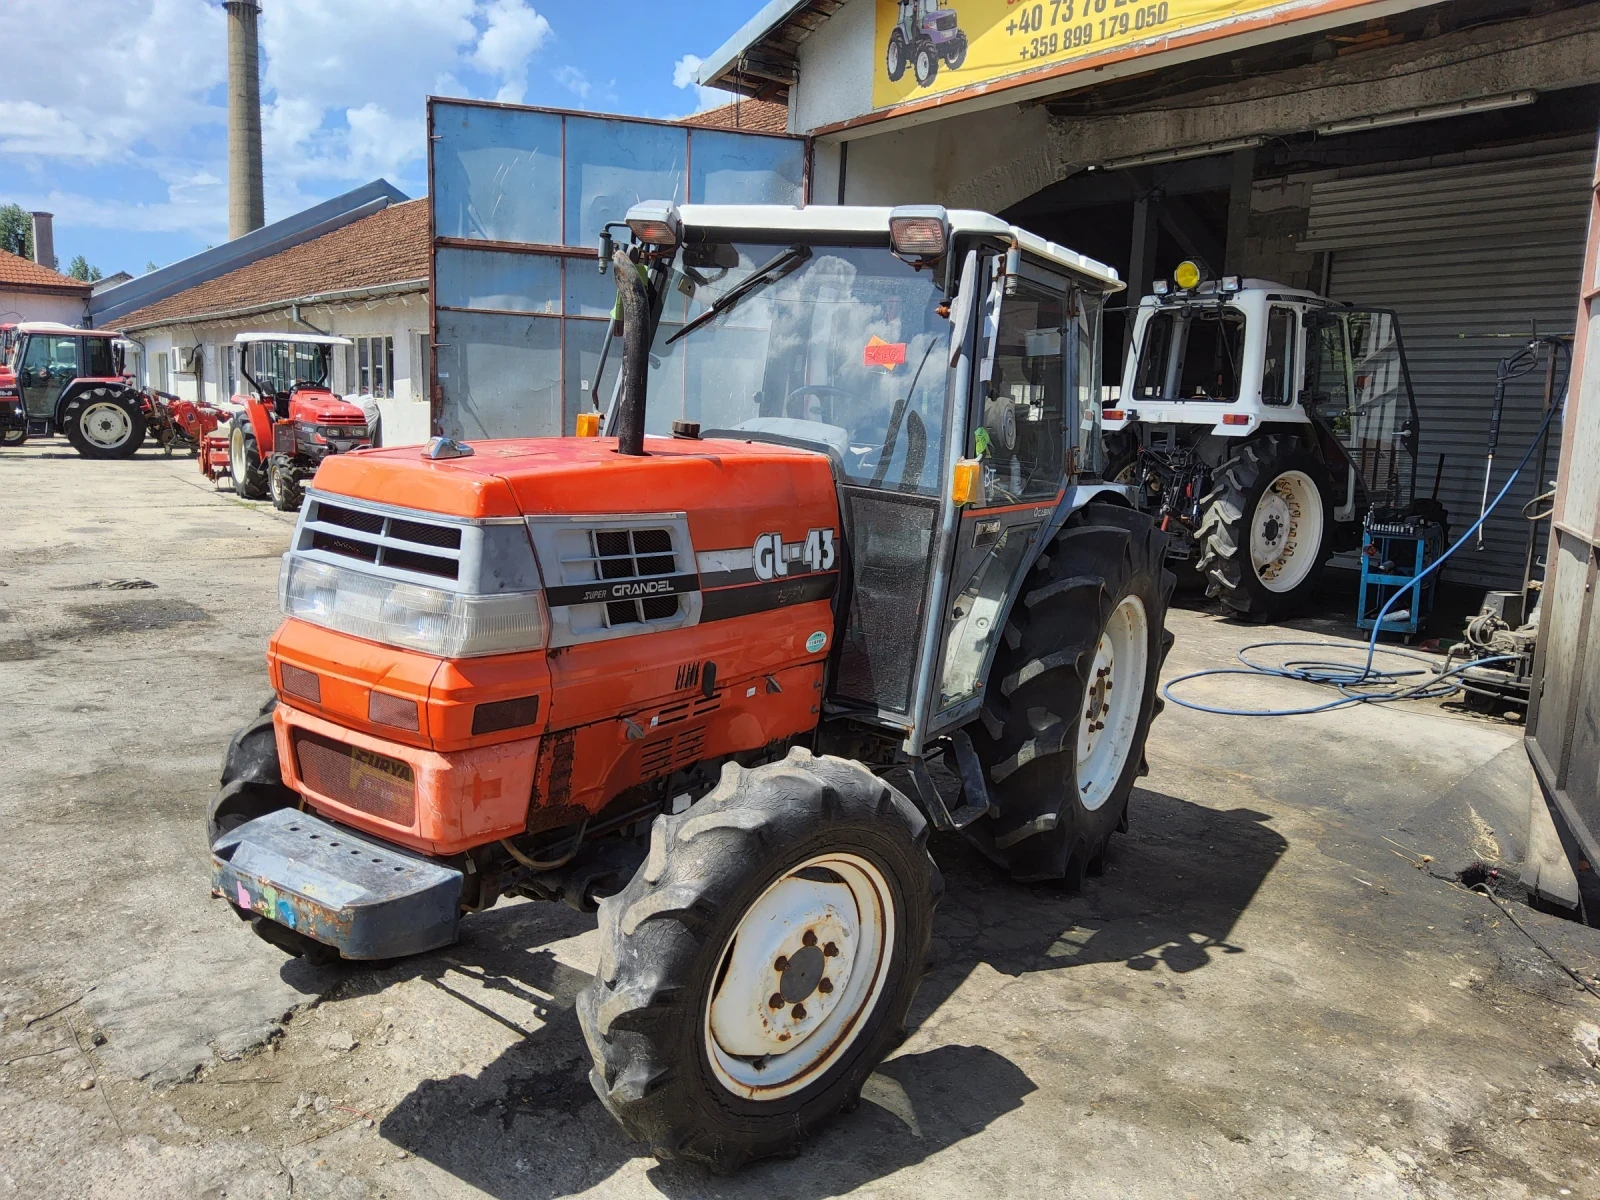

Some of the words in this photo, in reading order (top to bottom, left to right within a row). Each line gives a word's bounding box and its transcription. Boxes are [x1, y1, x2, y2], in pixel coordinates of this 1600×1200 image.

[1006, 4, 1043, 35] +40
[1050, 0, 1074, 26] 73
[1020, 32, 1058, 59] +359
[1063, 22, 1093, 50] 899
[1099, 12, 1130, 40] 179
[1135, 1, 1169, 30] 050
[753, 528, 836, 583] GL-43
[582, 589, 607, 600] SUPER
[612, 580, 674, 597] GRANDEL
